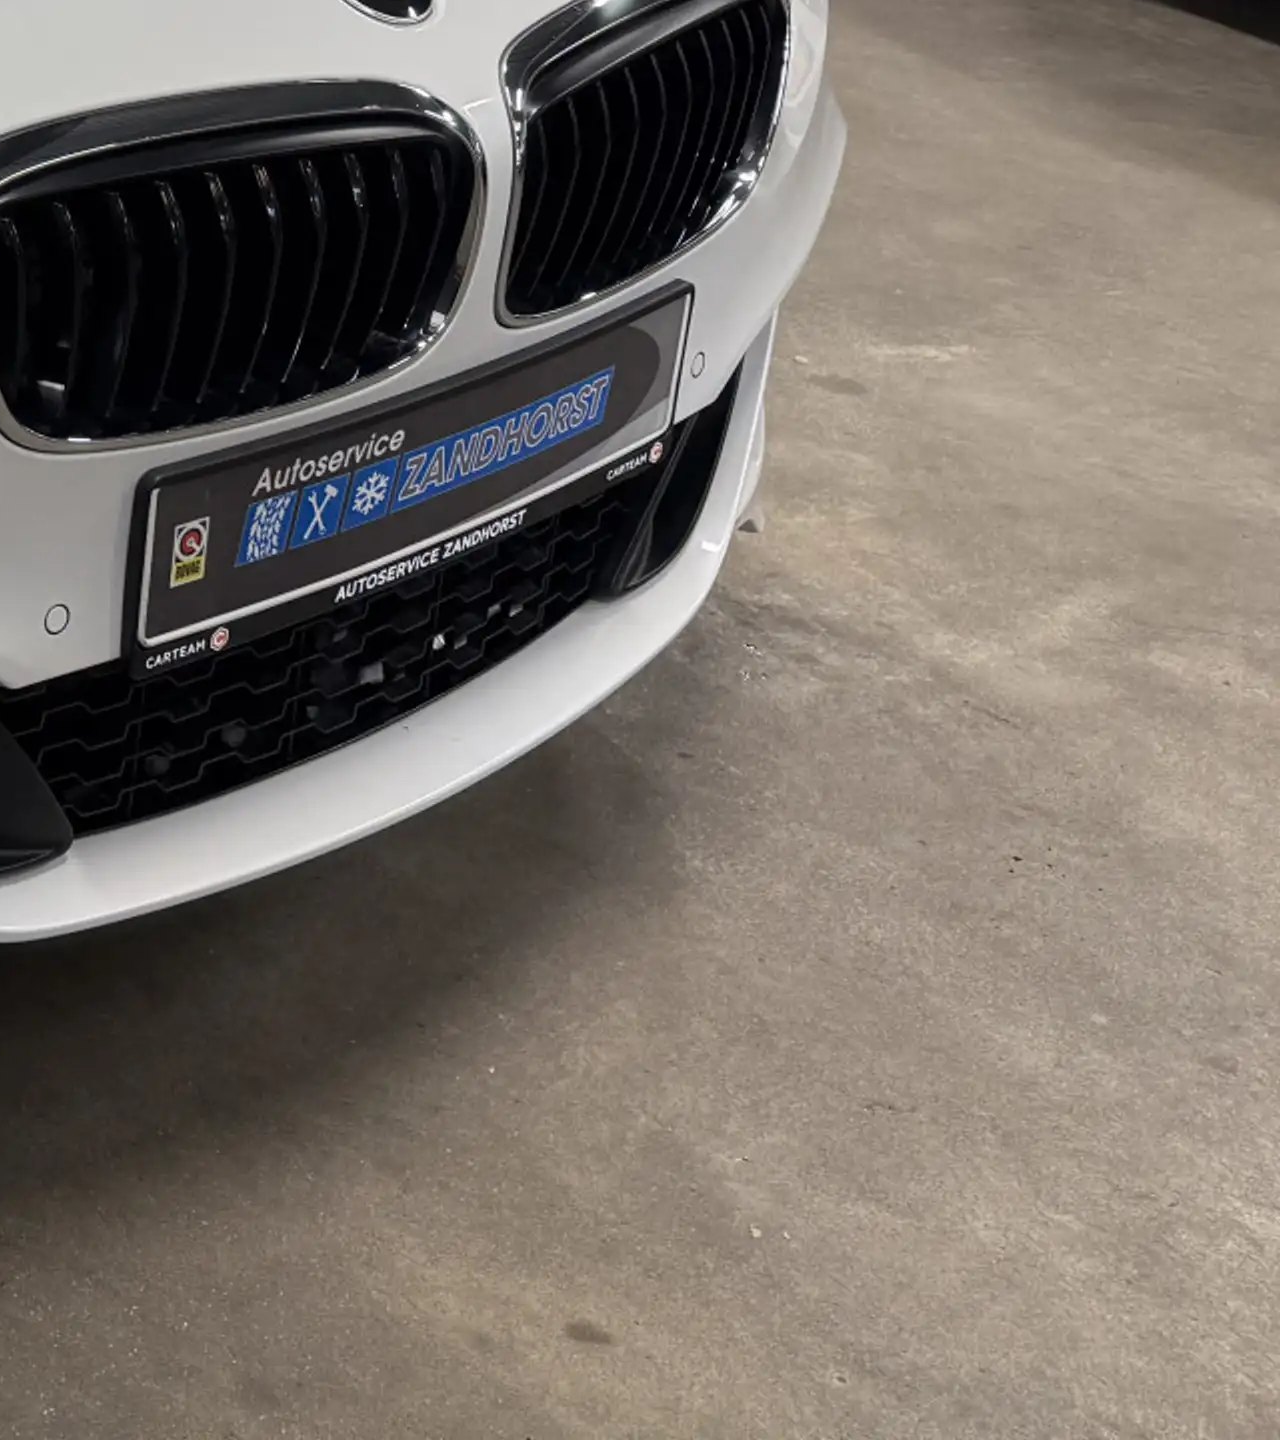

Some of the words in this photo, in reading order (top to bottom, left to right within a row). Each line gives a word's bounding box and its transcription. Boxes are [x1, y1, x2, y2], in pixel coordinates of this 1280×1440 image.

[252, 429, 406, 497] Autoservice
[398, 374, 610, 501] ZANDHORST
[606, 452, 647, 481] CARTEAM
[334, 548, 440, 603] AUTOSERVICE
[442, 509, 528, 559] ZANDHORST
[146, 638, 206, 669] CARTEAM
